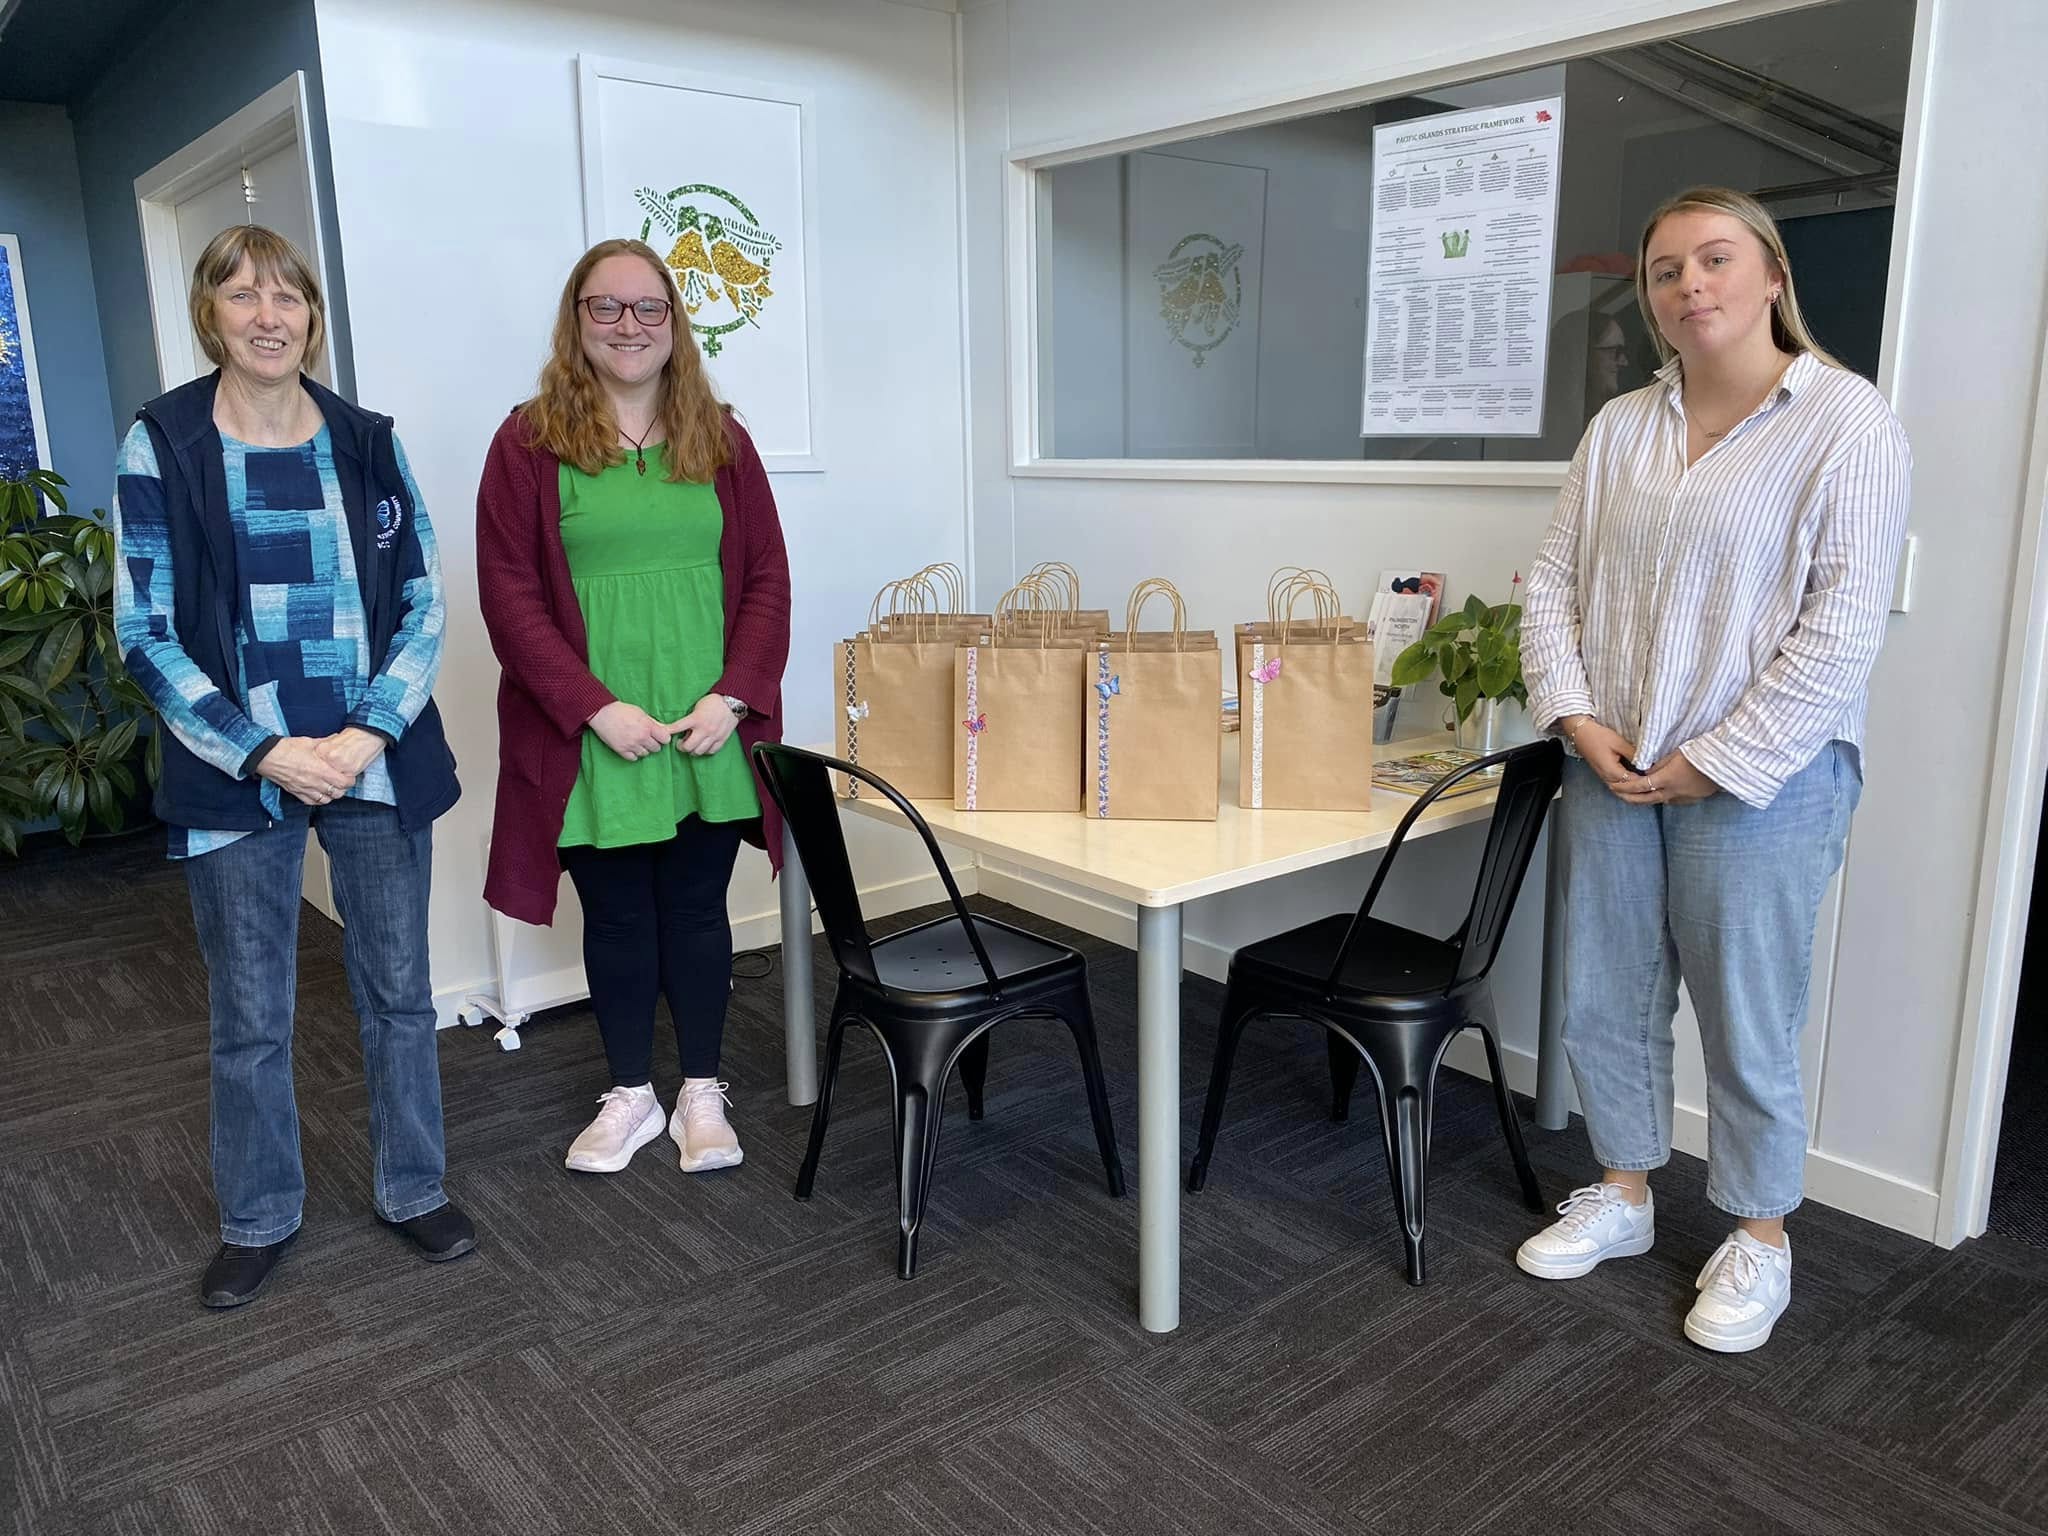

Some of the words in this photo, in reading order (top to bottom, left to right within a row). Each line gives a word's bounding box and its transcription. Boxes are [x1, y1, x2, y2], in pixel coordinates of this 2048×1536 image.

[1395, 134, 1418, 144] PACIFIC
[1418, 129, 1444, 141] ISLANDS
[1444, 123, 1480, 136] STRATEGIC
[1480, 115, 1525, 130] FRAMEWORK
